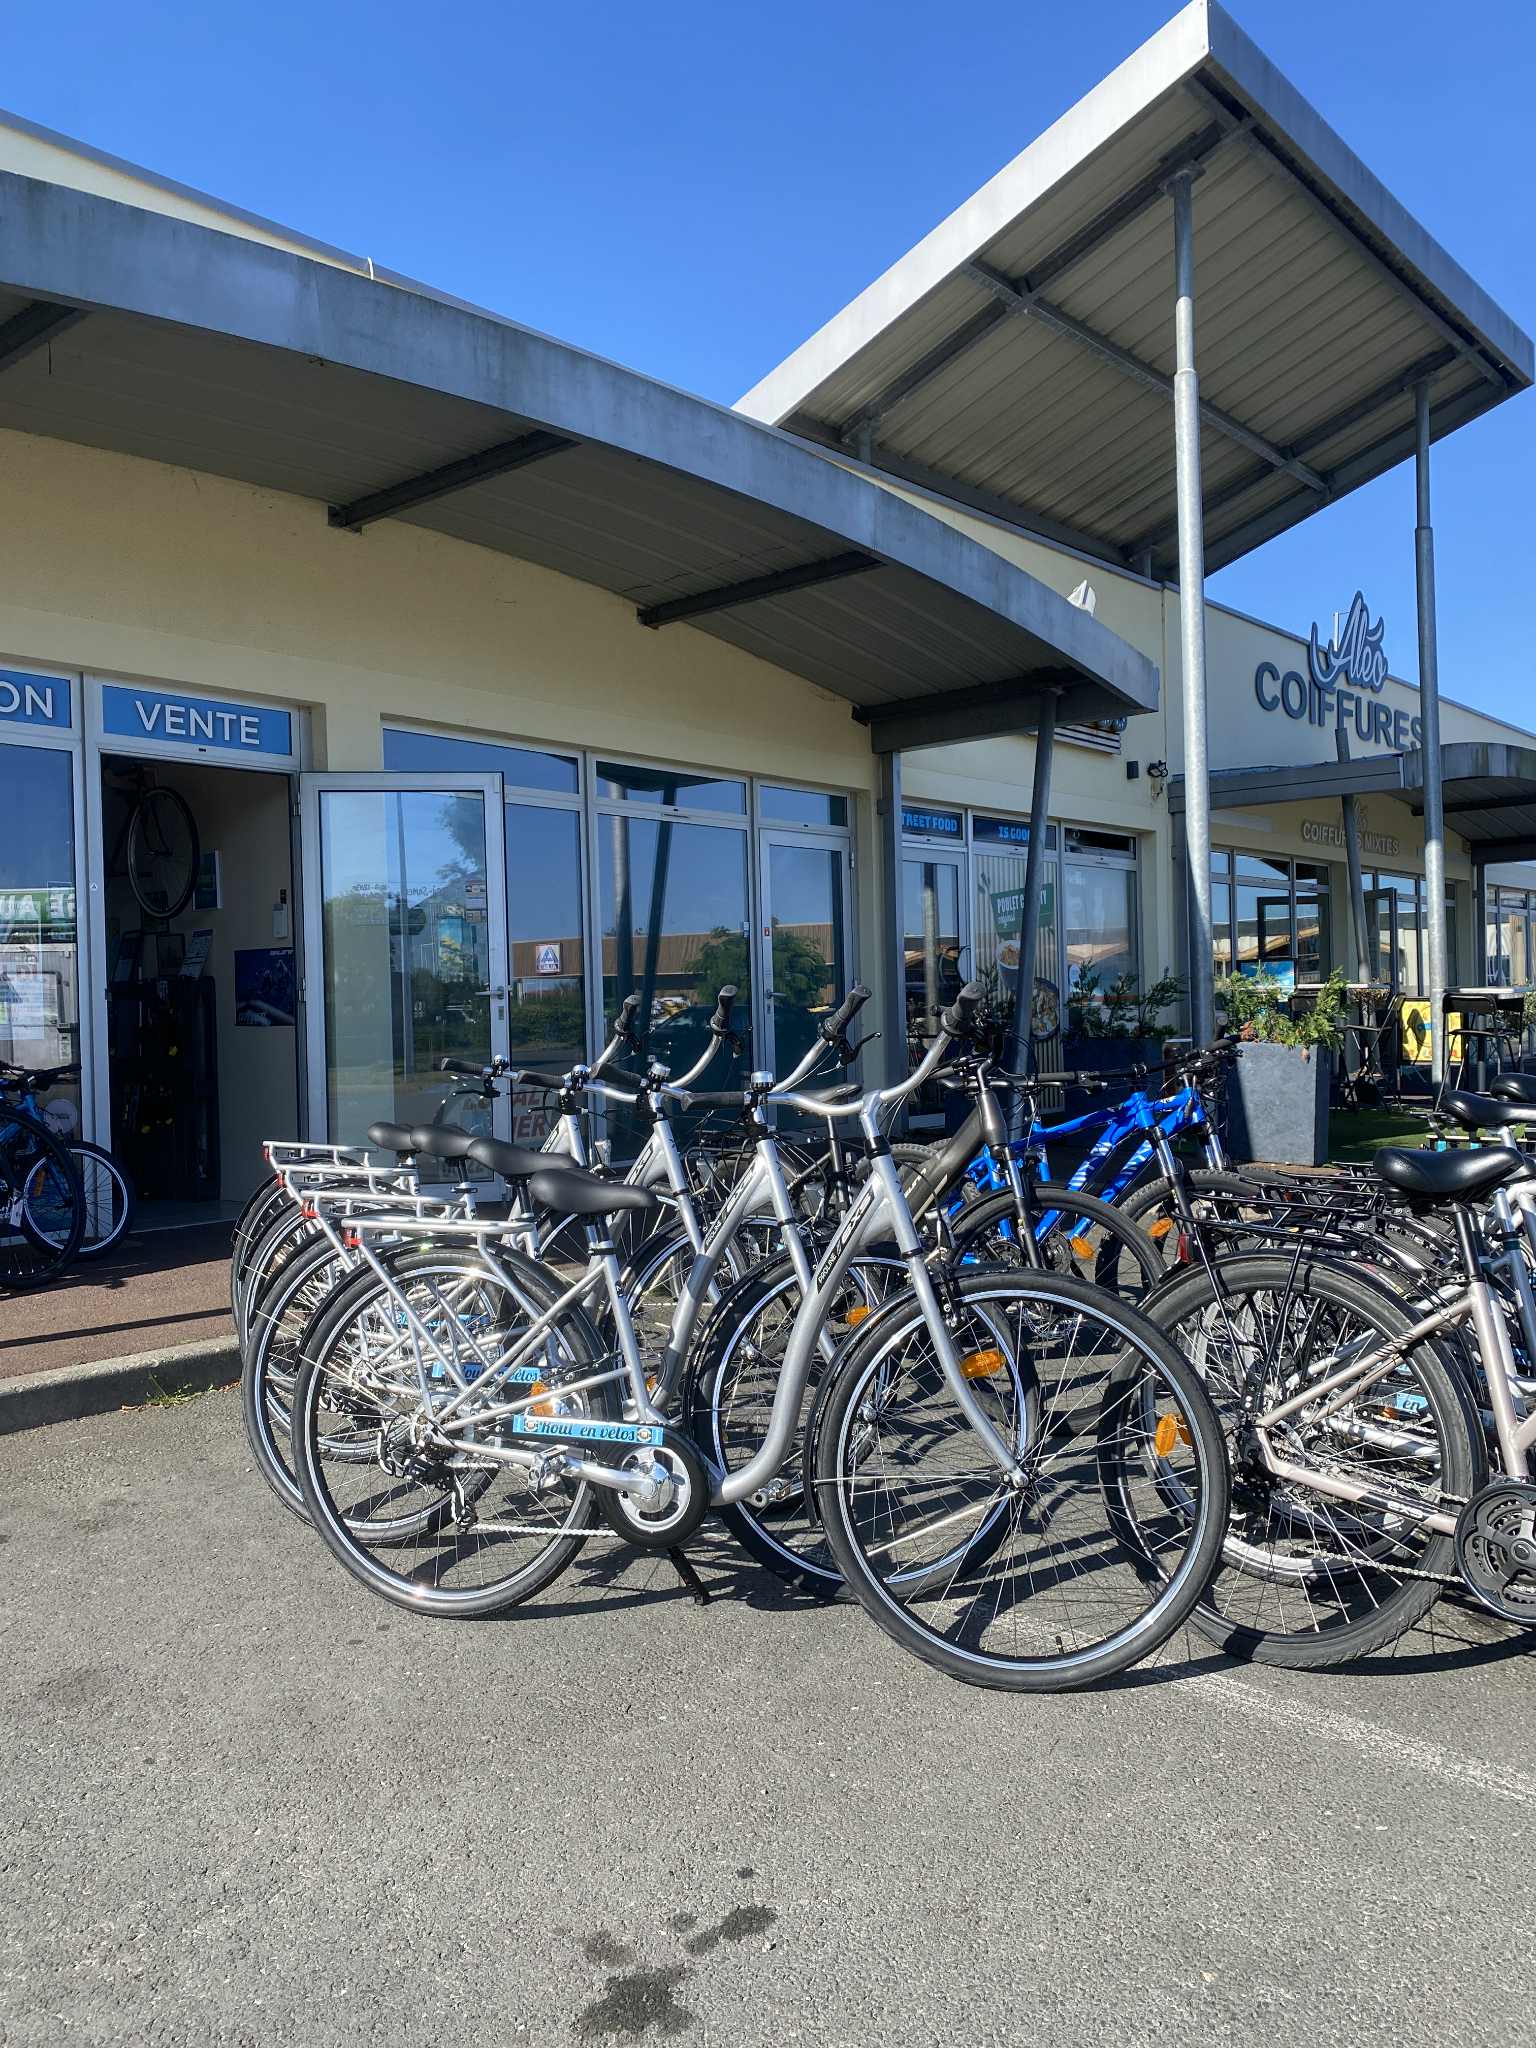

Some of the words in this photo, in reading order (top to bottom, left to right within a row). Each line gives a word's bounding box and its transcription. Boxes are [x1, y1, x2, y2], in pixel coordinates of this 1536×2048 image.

[1255, 661, 1423, 751] COIFFURES
[136, 701, 260, 745] VENTE
[901, 812, 931, 829] TREET
[933, 817, 958, 832] FOOD
[1011, 827, 1030, 841] GOO
[1303, 822, 1361, 848] COIFFUS
[1364, 832, 1400, 855] MIXTES
[997, 895, 1019, 914] POULET
[817, 1252, 838, 1283] PROLINE
